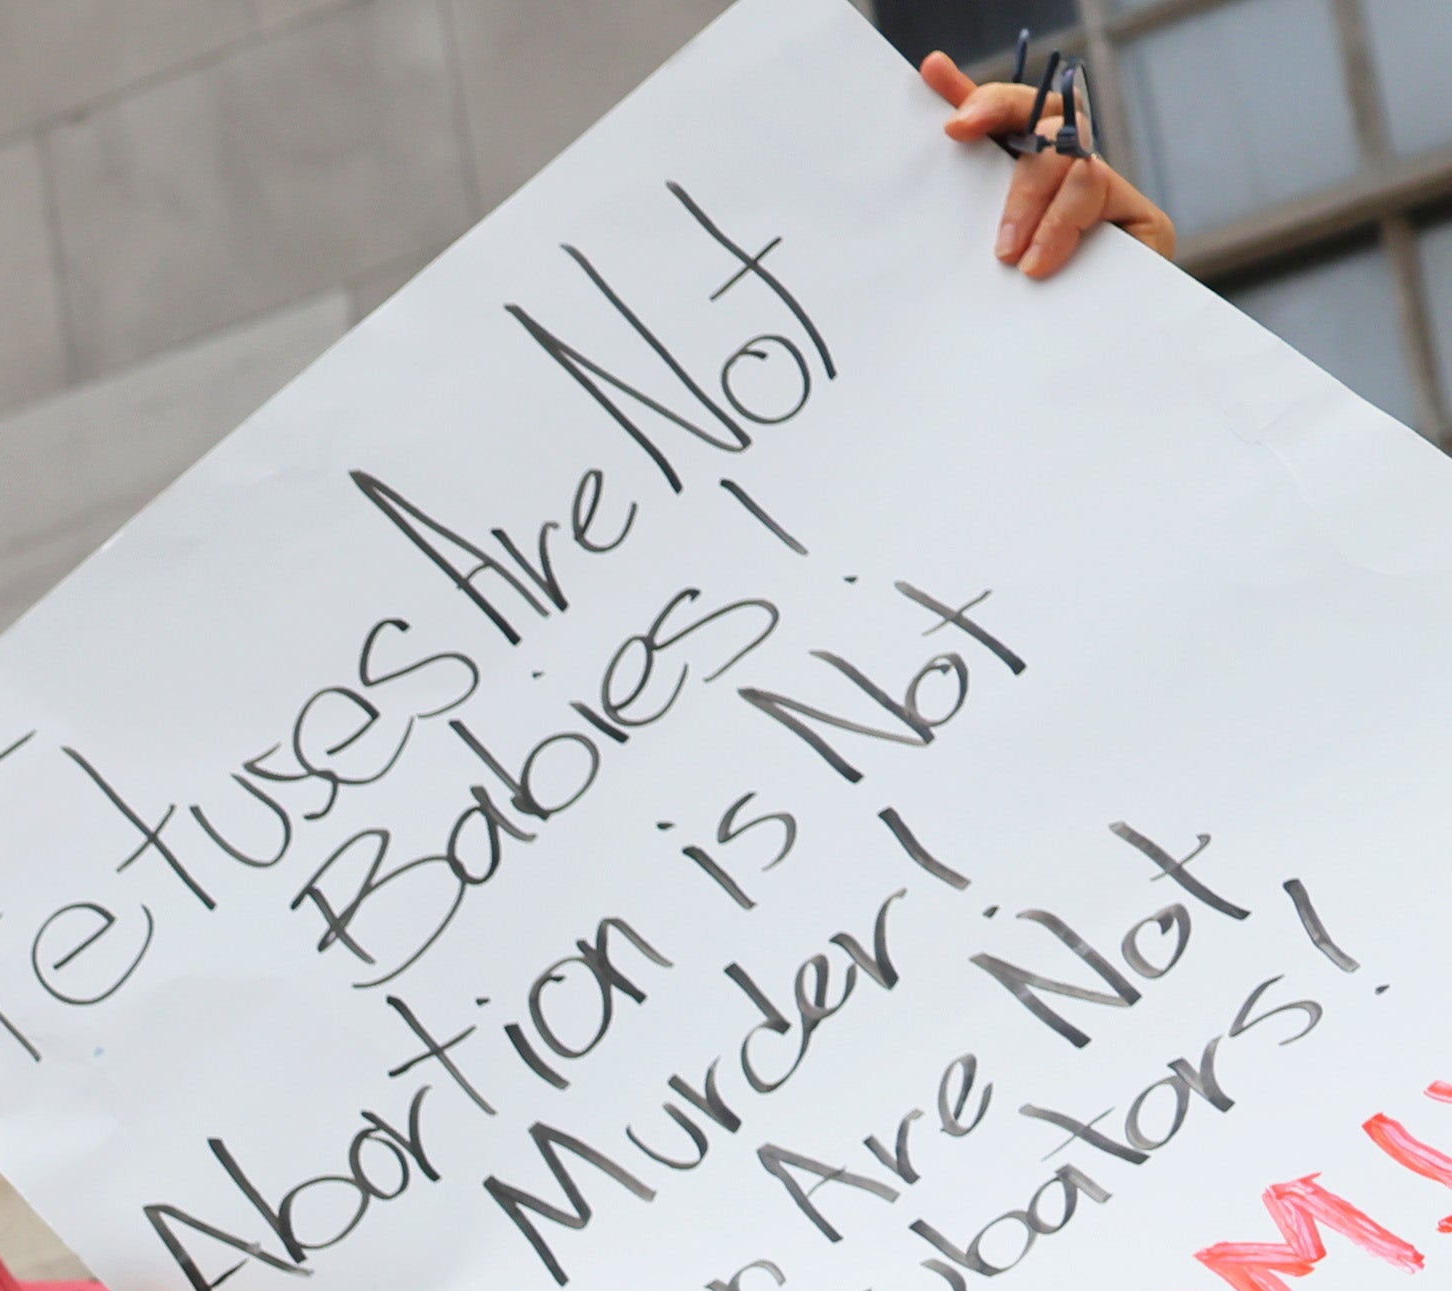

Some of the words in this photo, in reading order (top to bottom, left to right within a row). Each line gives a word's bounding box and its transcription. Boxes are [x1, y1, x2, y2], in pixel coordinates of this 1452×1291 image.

[350, 465, 636, 645] Are
[504, 179, 838, 494] Not
[292, 477, 858, 990] Babies!
[657, 791, 798, 909] is
[740, 580, 1027, 785] Not
[484, 808, 999, 1285] Murder!
[757, 1054, 993, 1243] Are
[971, 821, 1250, 1048] Not
